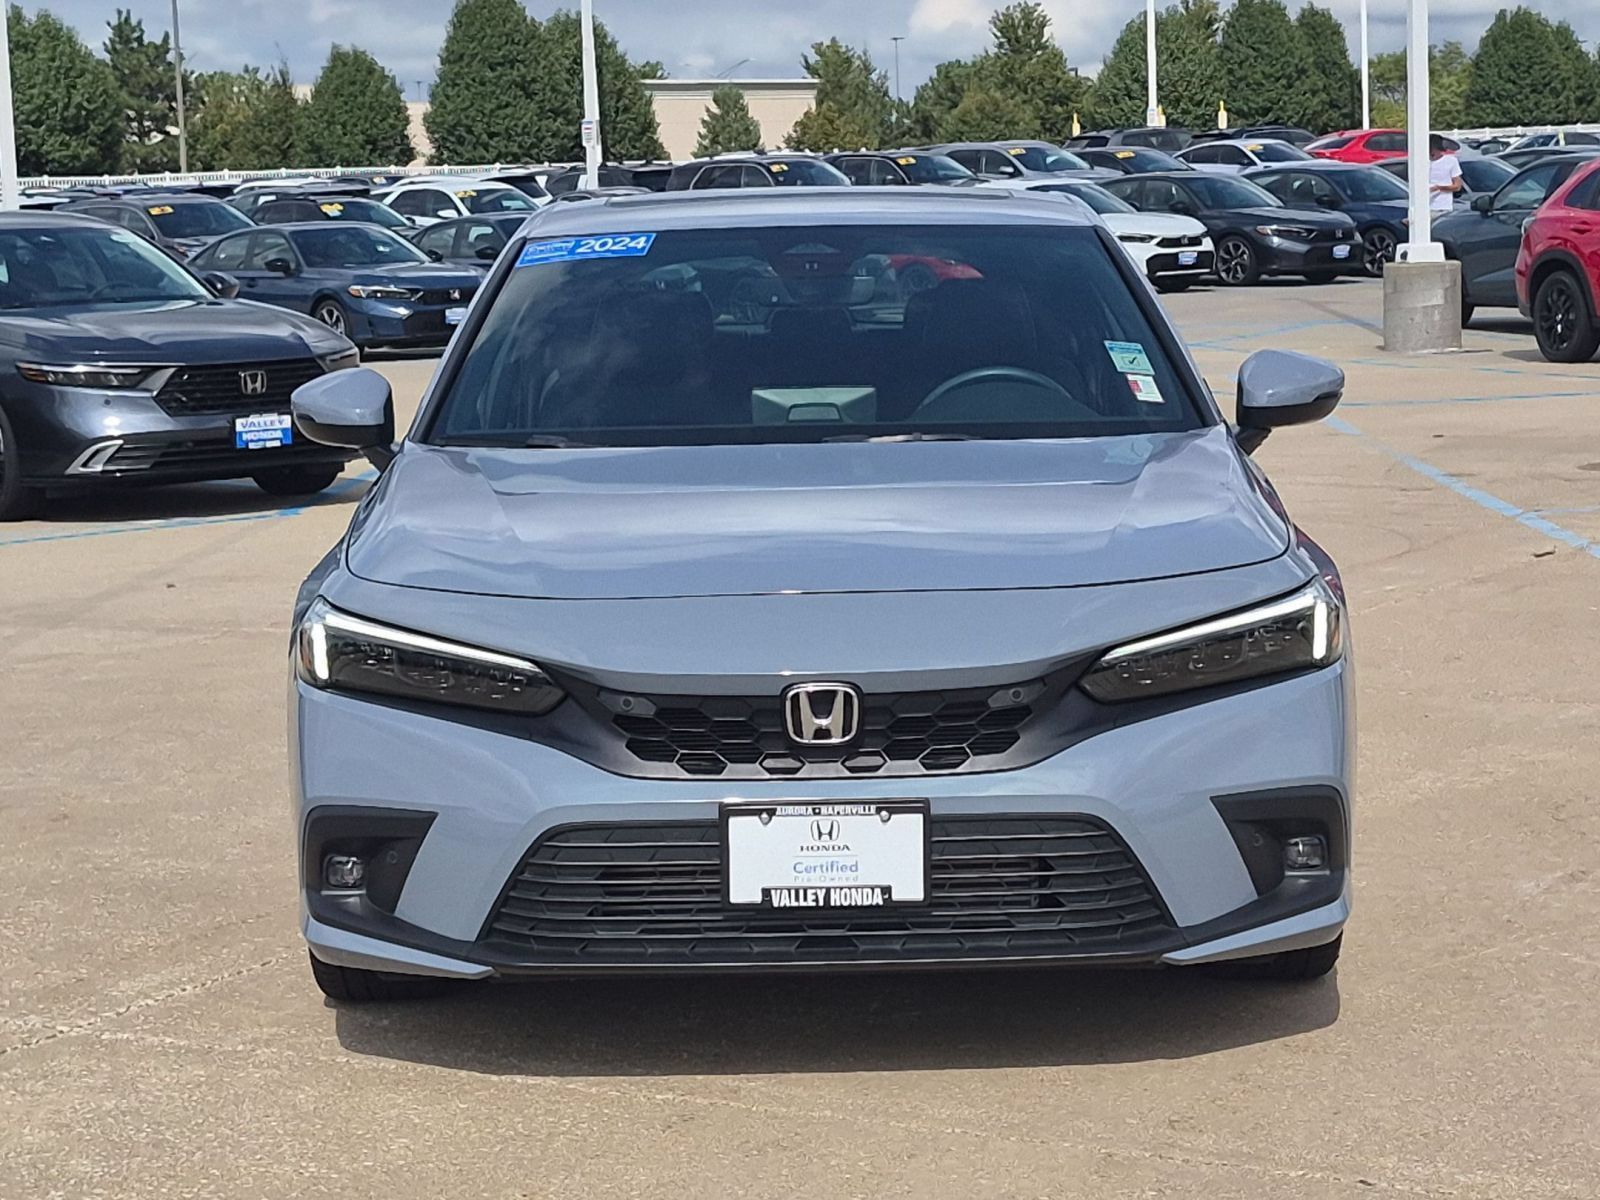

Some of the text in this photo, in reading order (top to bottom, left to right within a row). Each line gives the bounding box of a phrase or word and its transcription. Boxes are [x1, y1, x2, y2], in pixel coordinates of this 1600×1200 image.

[575, 235, 648, 253] 2024
[240, 419, 284, 429] VALLEY
[800, 844, 851, 852] HONDA
[793, 860, 859, 874] Certified
[794, 875, 859, 883] Pre-Owned
[770, 887, 884, 907] VALLEY HONDA
